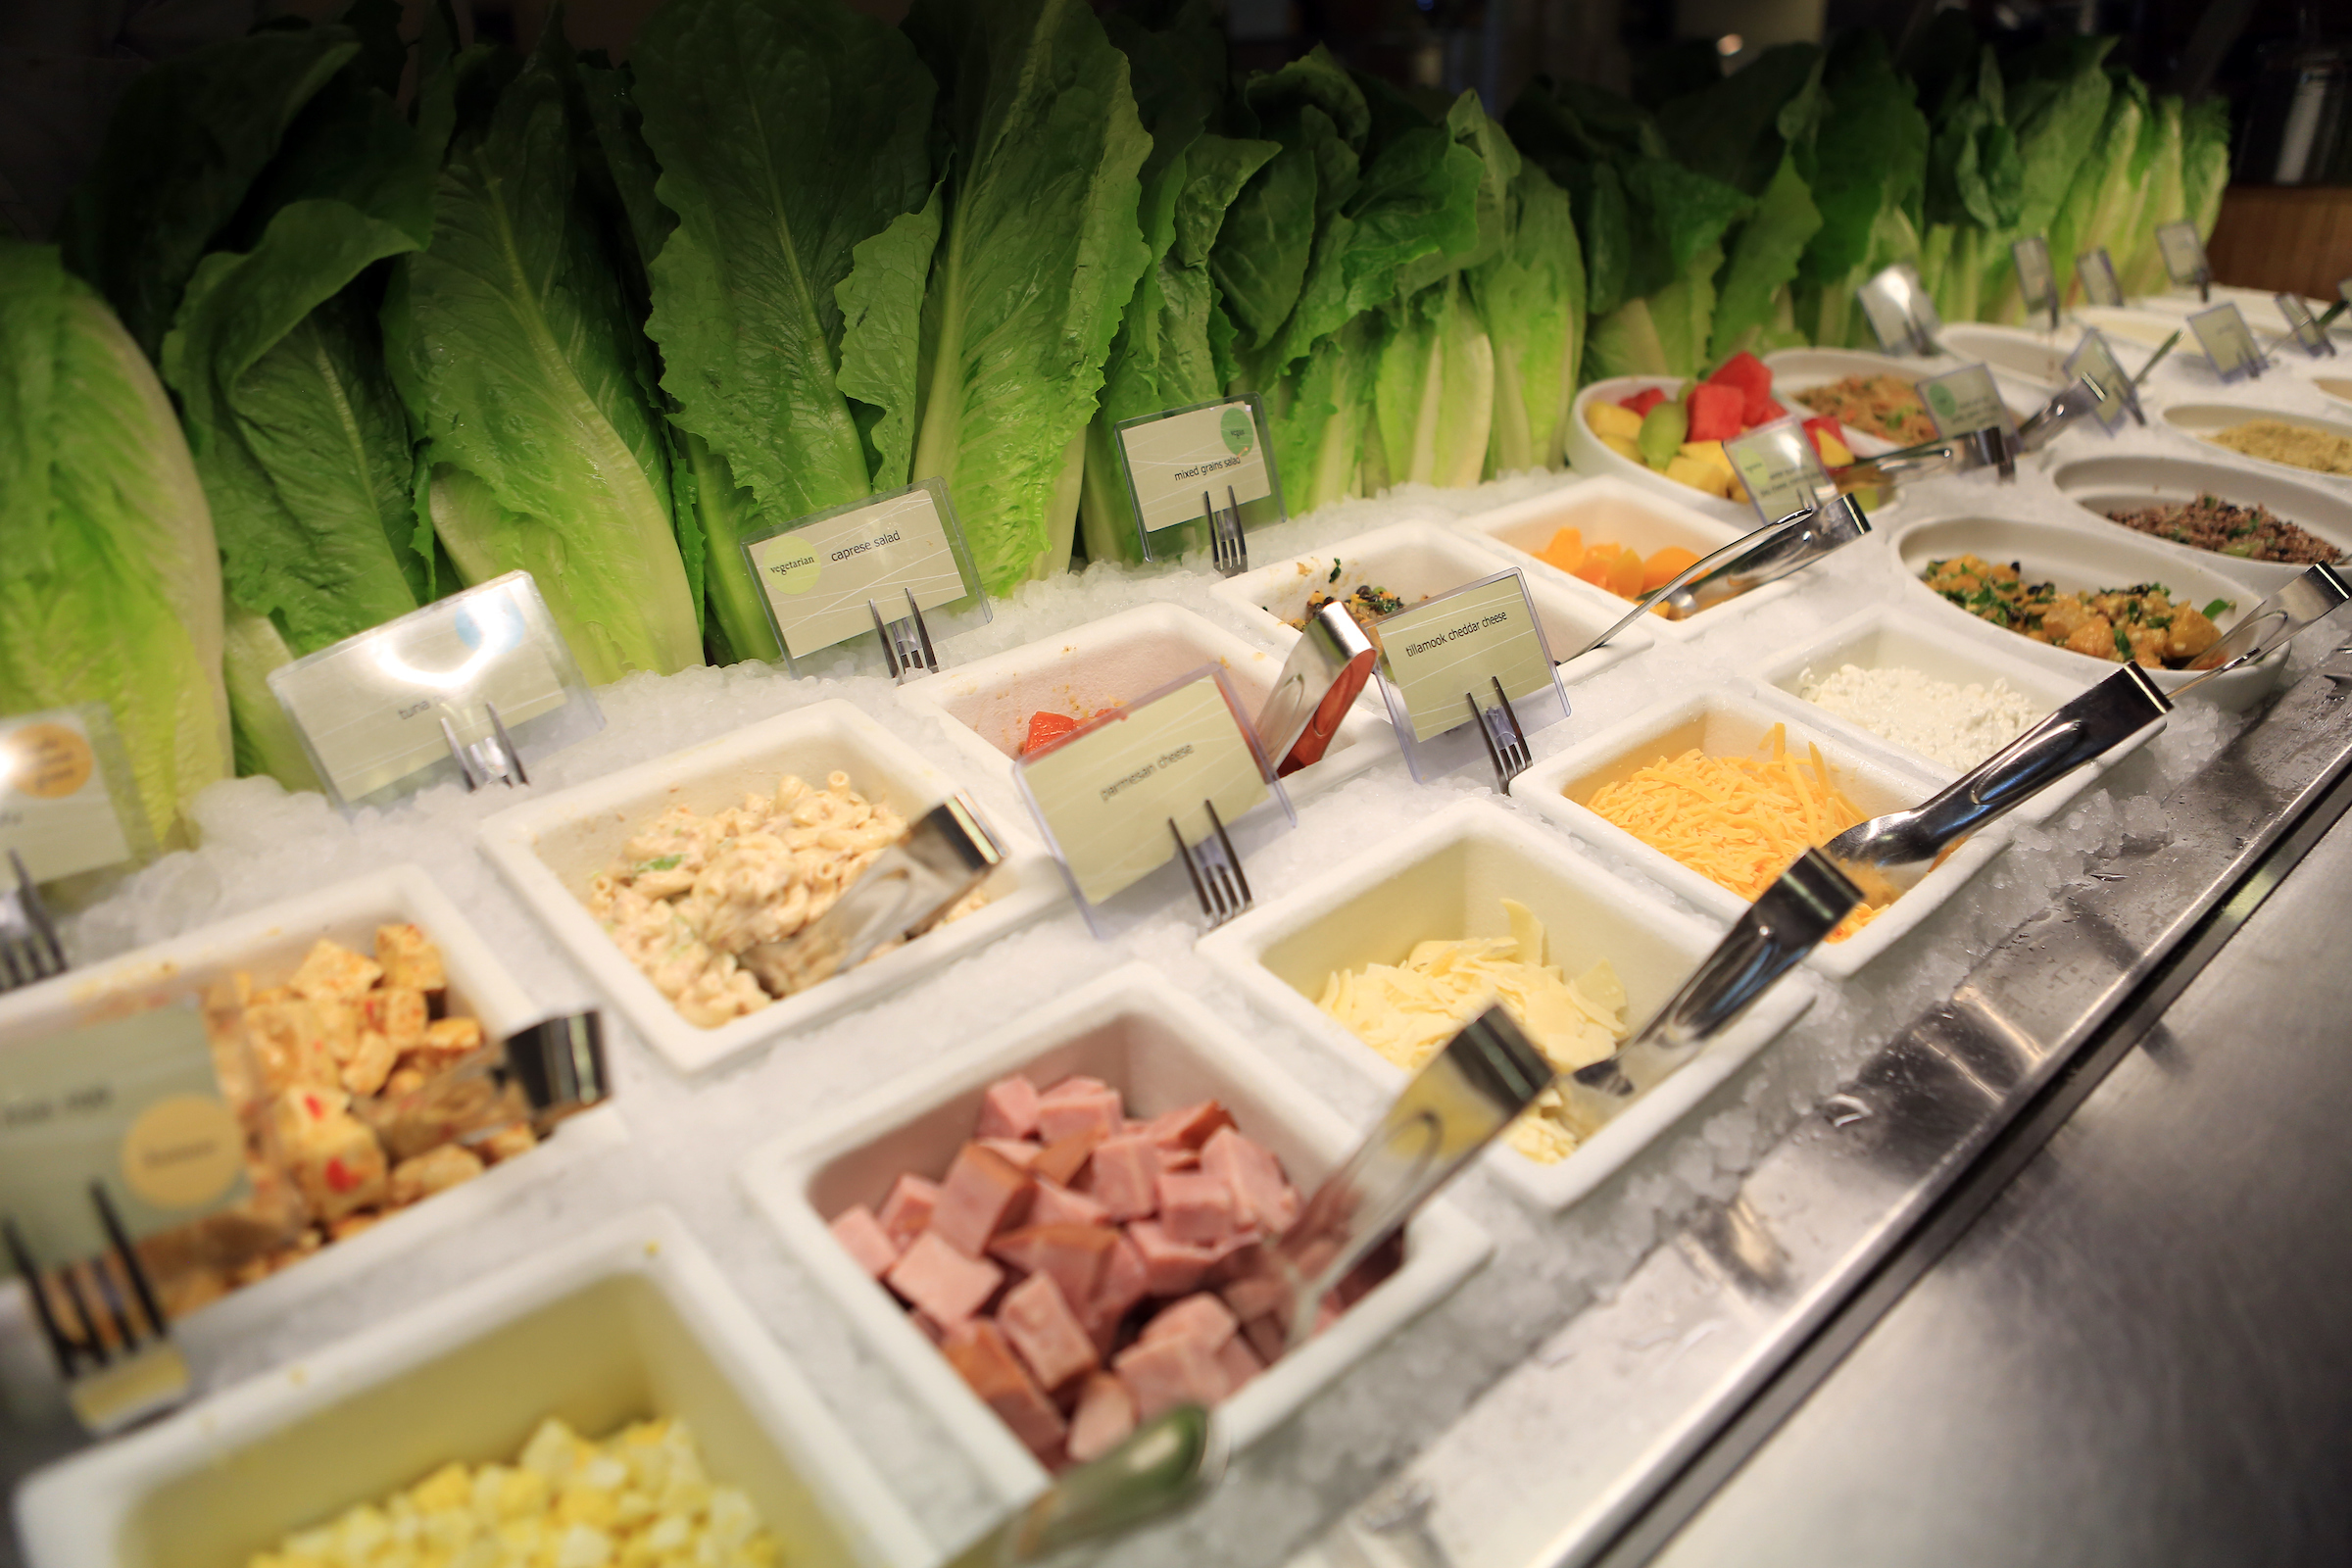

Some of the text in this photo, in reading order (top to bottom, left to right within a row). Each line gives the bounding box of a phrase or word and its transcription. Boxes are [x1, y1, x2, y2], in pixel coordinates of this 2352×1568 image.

[1174, 457, 1242, 481] mixed grains salad
[831, 530, 901, 562] caprese salad
[770, 555, 815, 576] vegetarian
[1405, 612, 1508, 658] tillamook cheddar cheese
[398, 700, 430, 720] tuna
[1100, 744, 1195, 803] parmesan cheese
